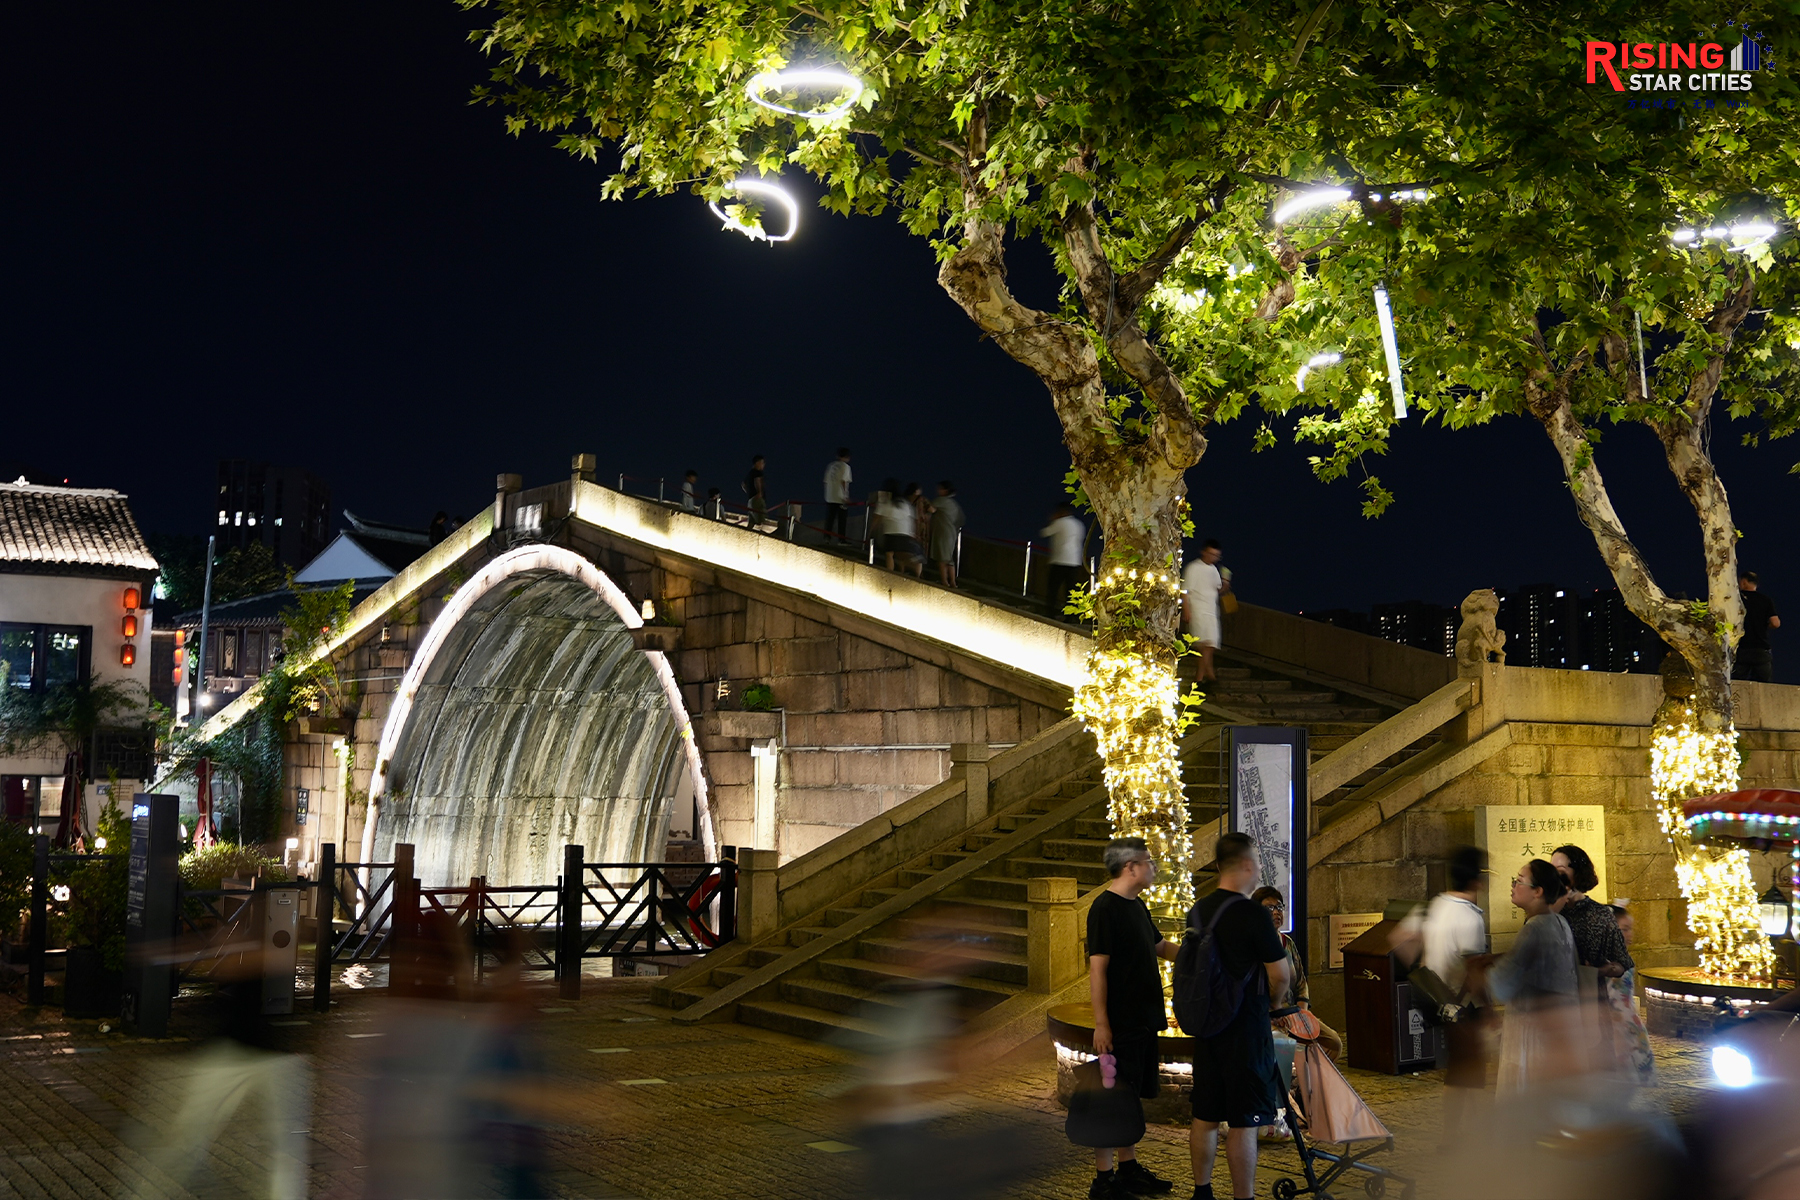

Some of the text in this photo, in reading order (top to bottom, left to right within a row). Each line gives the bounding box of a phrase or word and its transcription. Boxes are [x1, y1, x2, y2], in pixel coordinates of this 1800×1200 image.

[1498, 818, 1595, 832] 全国重点文物保护单位
[1521, 842, 1574, 857] 大运
